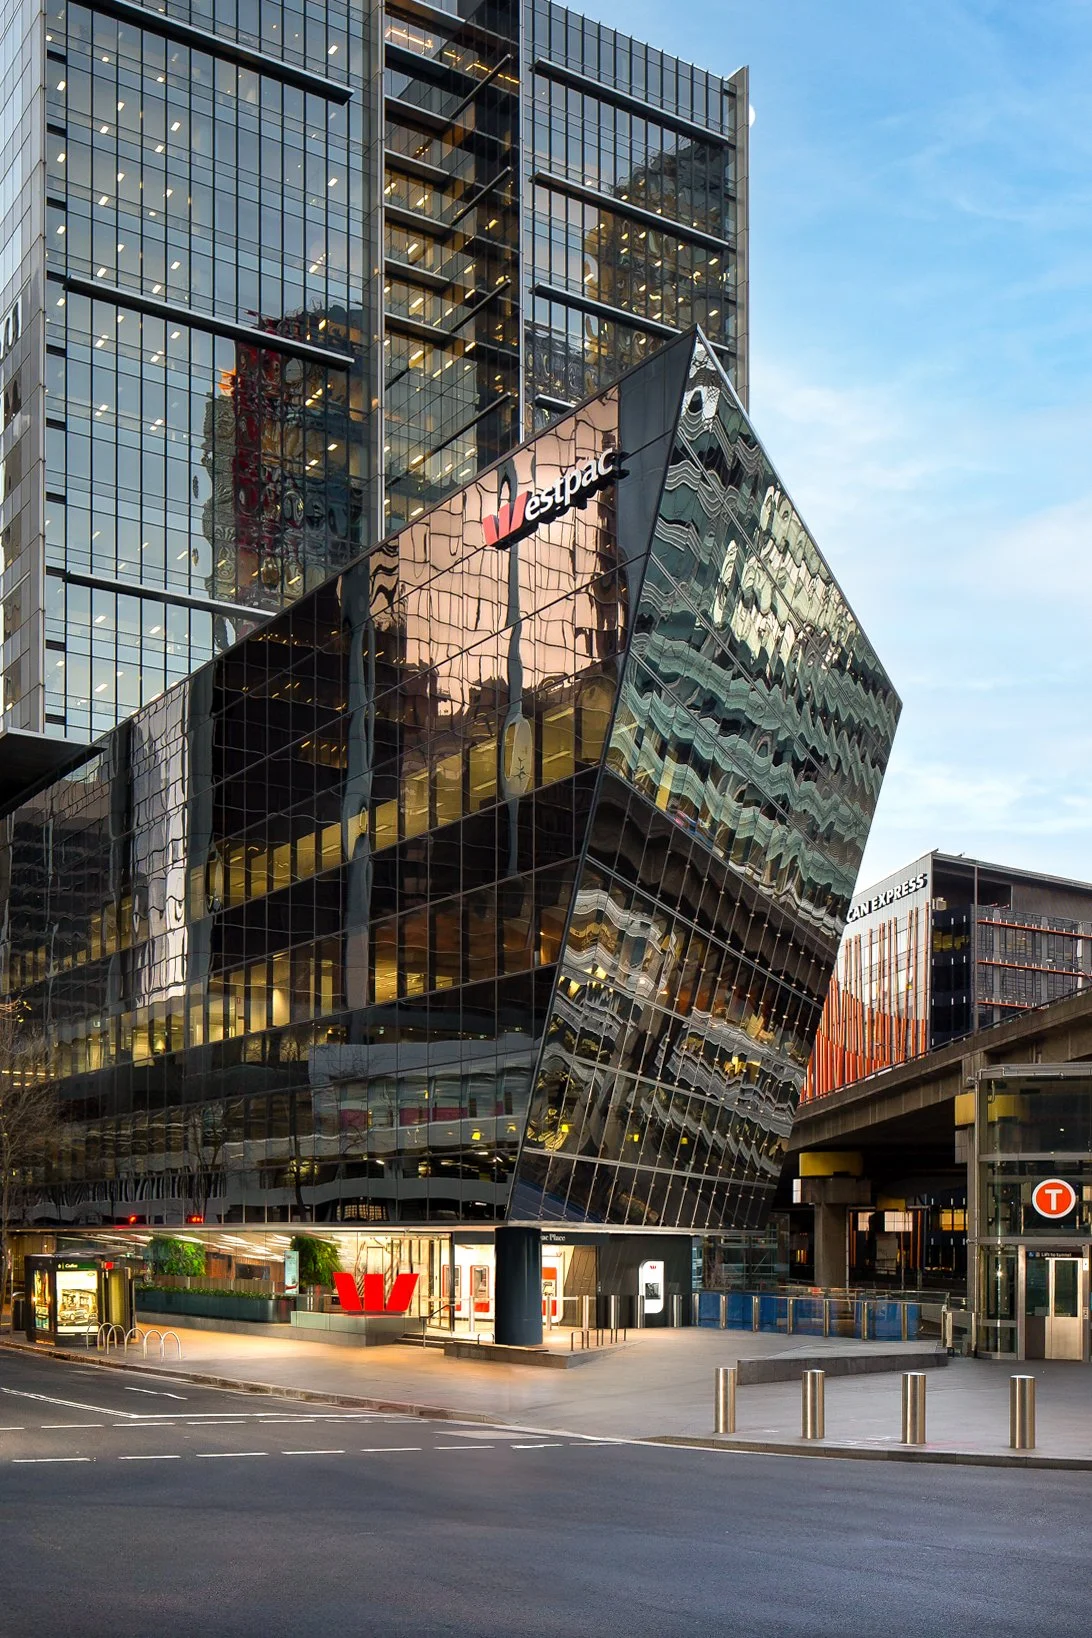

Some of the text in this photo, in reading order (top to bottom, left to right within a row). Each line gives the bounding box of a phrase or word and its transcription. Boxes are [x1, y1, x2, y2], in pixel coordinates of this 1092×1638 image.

[482, 447, 615, 546] Westpac
[871, 873, 926, 911] EXPRESS
[1044, 1189, 1063, 1211] T
[549, 1233, 566, 1241] Place
